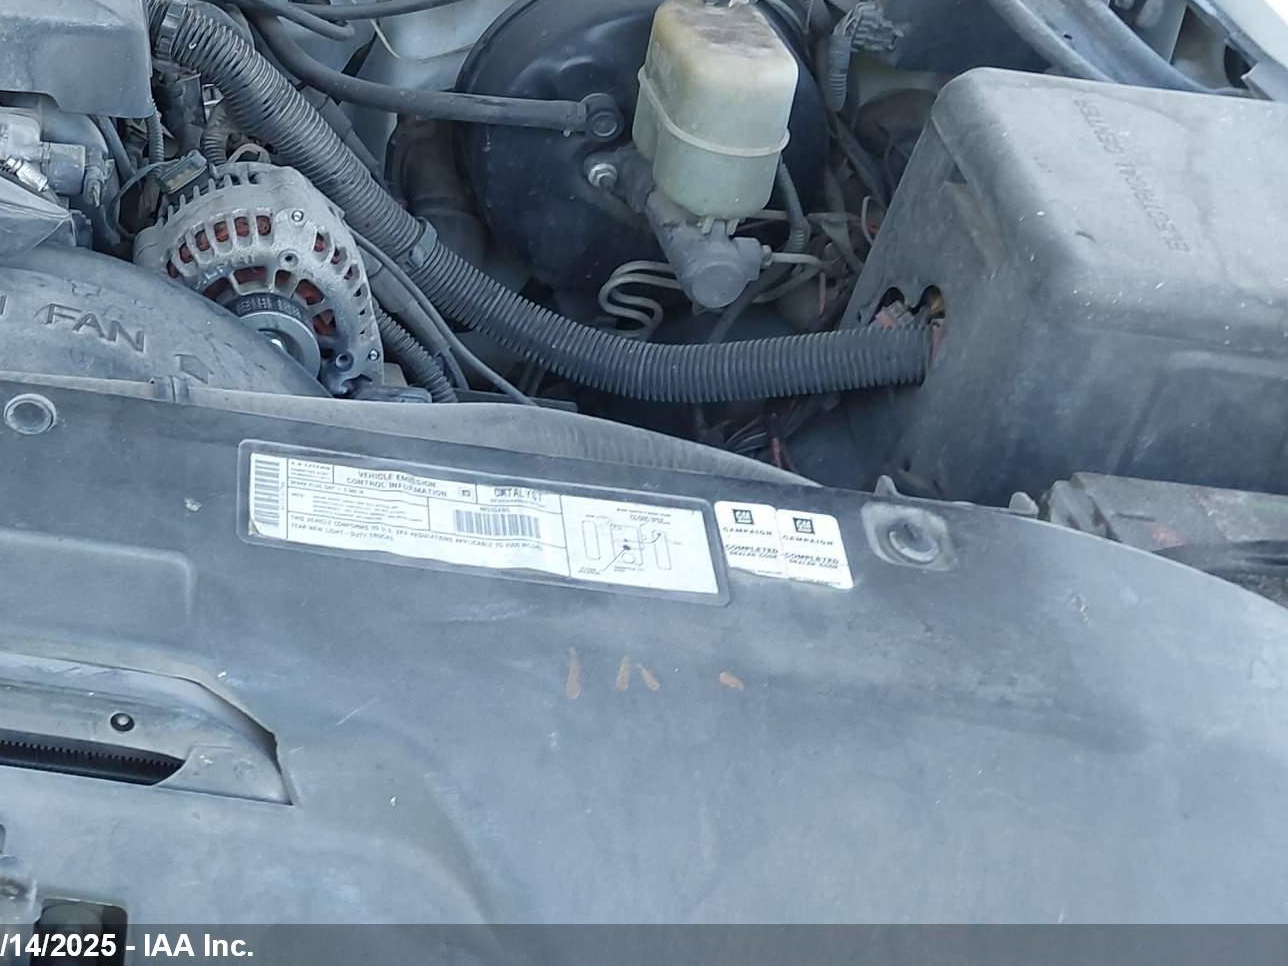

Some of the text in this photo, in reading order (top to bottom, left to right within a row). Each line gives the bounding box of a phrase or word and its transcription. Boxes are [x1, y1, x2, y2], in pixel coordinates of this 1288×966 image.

[43, 301, 146, 354] FAN
[358, 471, 393, 481] VEHICLE
[346, 477, 387, 489] CONTROL
[388, 480, 448, 497] INFORMATION
[494, 487, 543, 503] CATALYST
[722, 526, 773, 536] CAMPAIGN
[782, 535, 835, 546] CAMPAIGN
[725, 544, 779, 554] COMPLETED
[784, 552, 840, 564] COMPLETED
